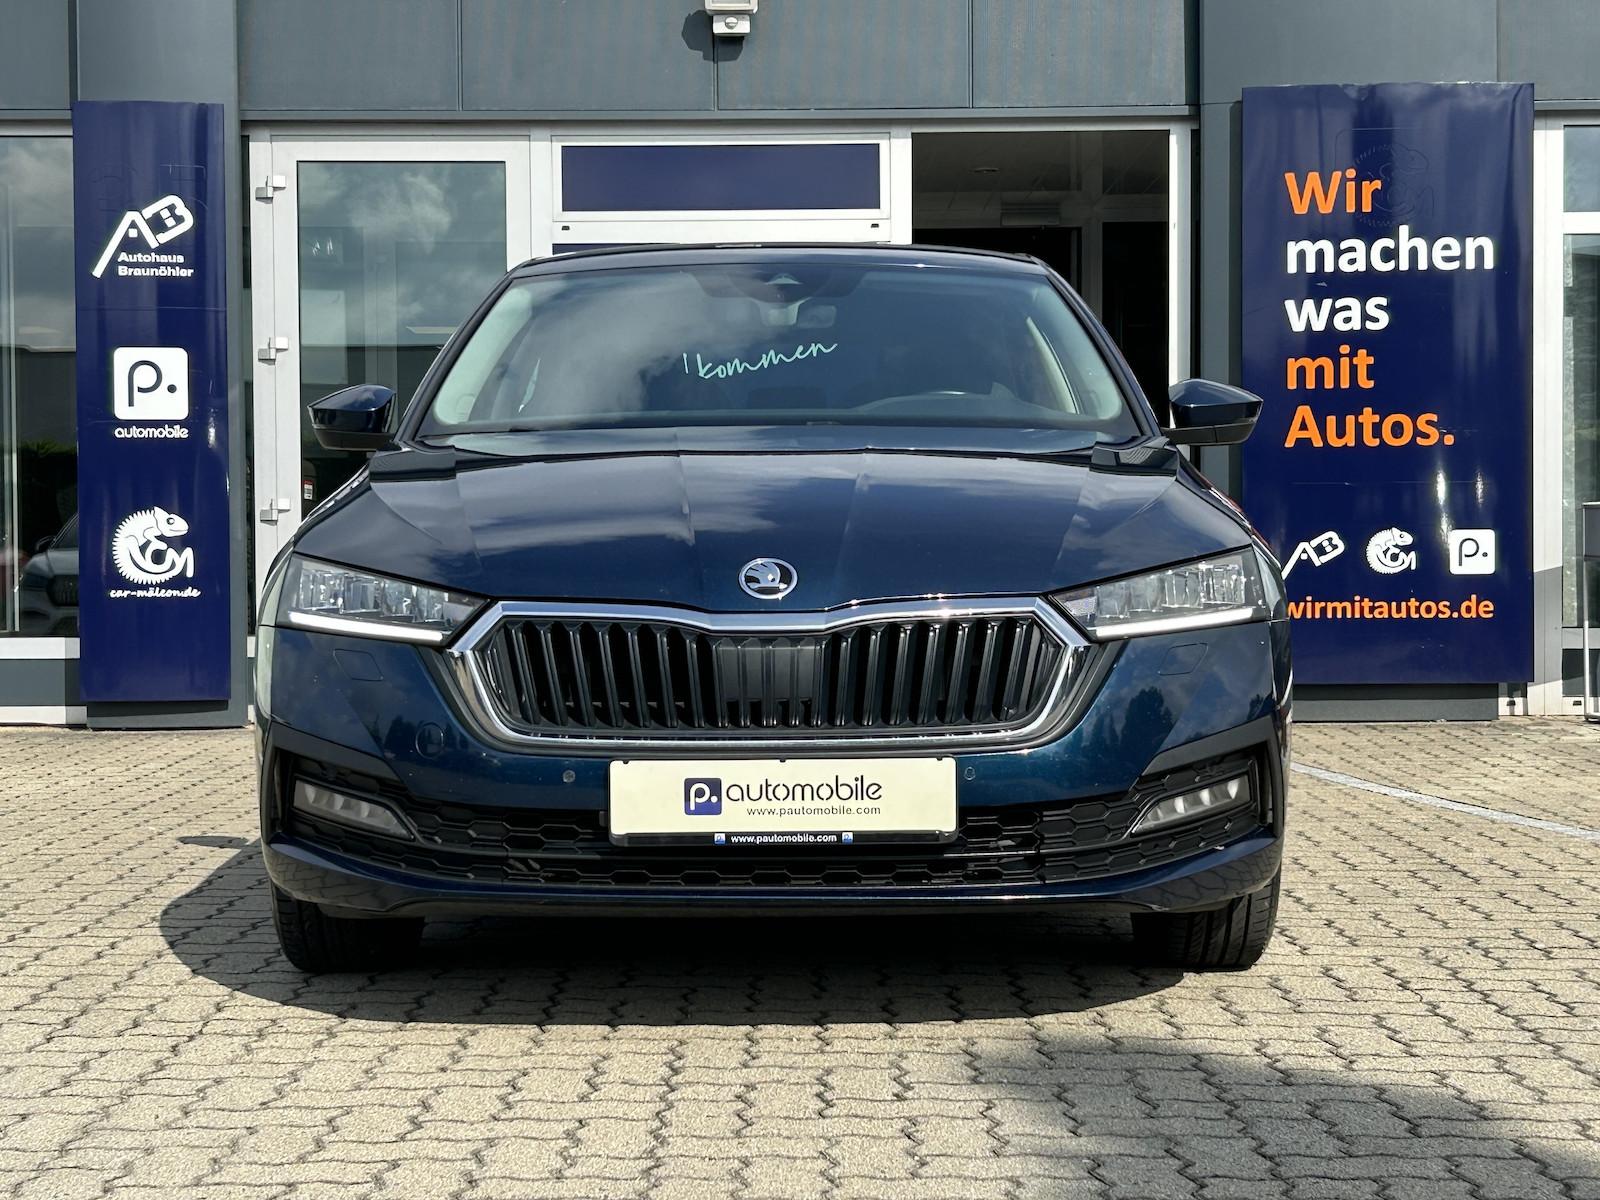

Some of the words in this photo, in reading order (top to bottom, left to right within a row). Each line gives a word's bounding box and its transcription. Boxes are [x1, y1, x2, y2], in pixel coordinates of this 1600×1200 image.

[1284, 168, 1382, 215] Wir
[117, 252, 185, 263] Autohaus
[1286, 224, 1495, 274] machen
[118, 265, 194, 277] Braunöhler
[1284, 296, 1390, 332] was
[1286, 344, 1375, 389] mit
[114, 425, 189, 439] automobile
[1284, 405, 1455, 448] Autos.
[1287, 594, 1494, 620] wirmitautos.de
[726, 775, 882, 801] automobile
[746, 805, 882, 818] www.pautomobile.com
[730, 833, 838, 845] www.pautomobile.com
